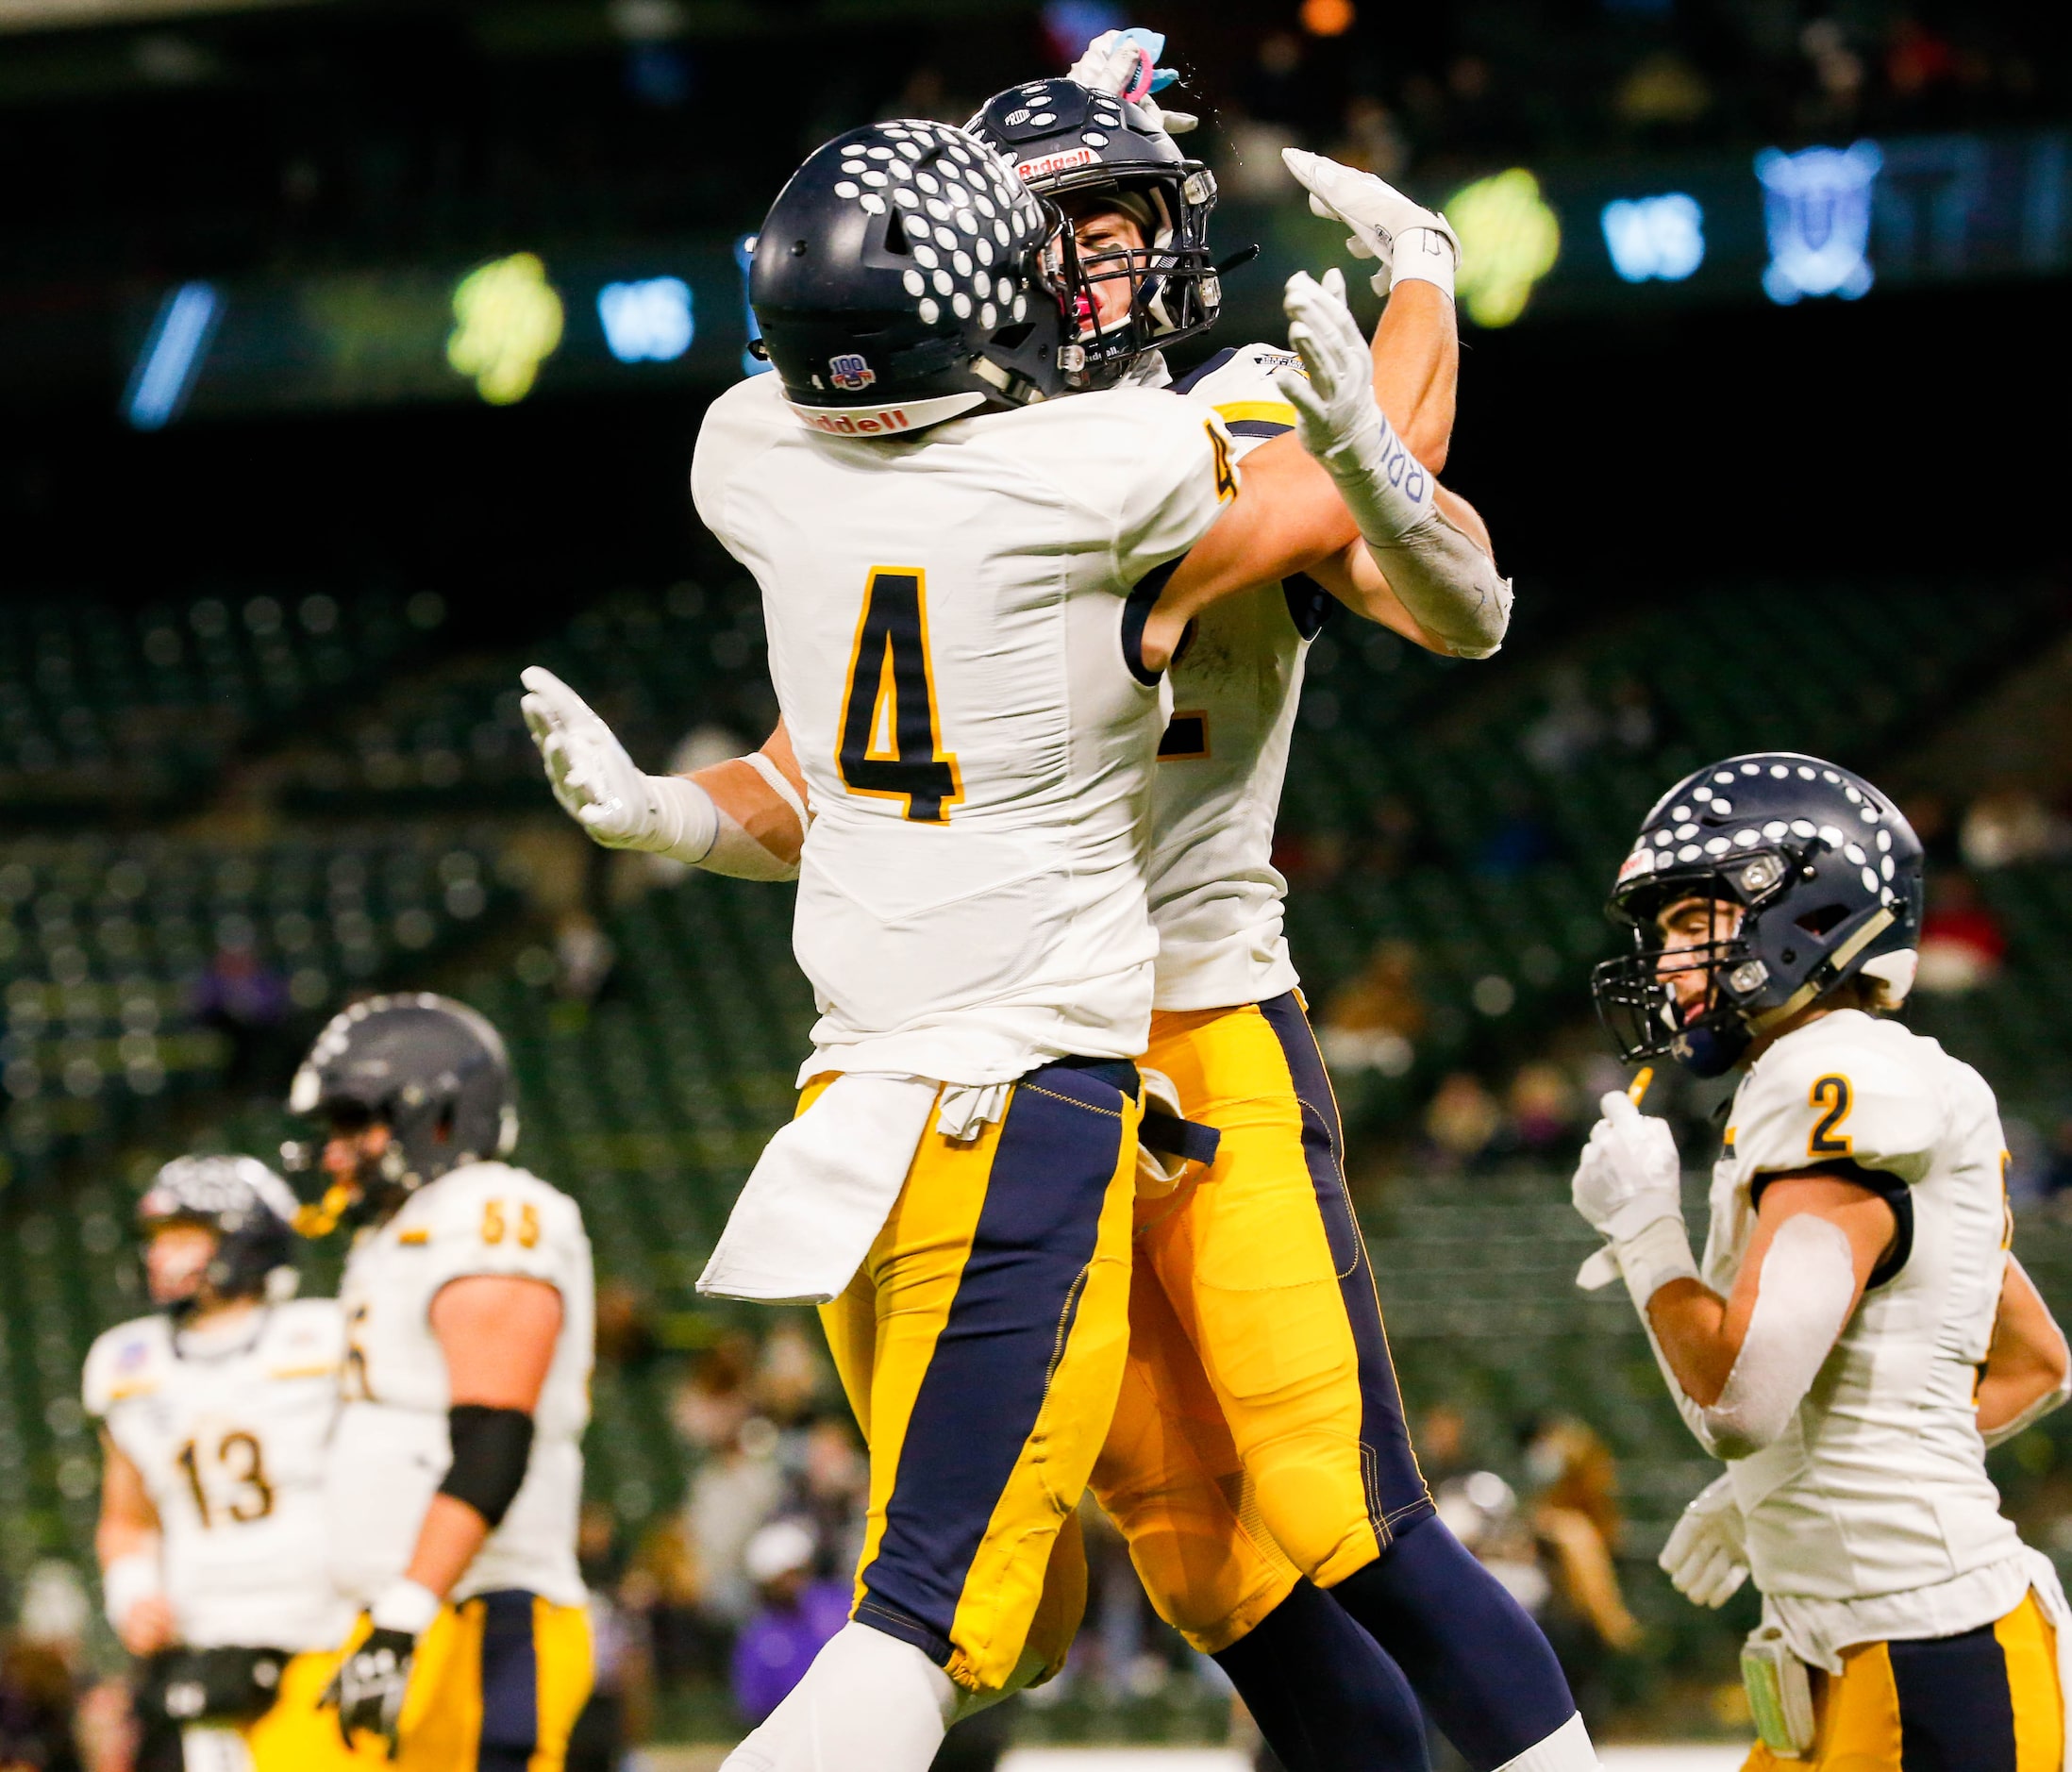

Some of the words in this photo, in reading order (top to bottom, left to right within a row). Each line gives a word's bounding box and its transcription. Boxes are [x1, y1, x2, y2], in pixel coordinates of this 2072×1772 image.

[1003, 109, 1031, 126] PRIDE
[1018, 150, 1092, 181] Riddell
[831, 356, 865, 376] 100
[1202, 417, 1238, 505] 4
[834, 565, 965, 827] 4
[1807, 1072, 1854, 1159] 2
[481, 1198, 540, 1250] 55
[174, 1430, 275, 1530] 13
